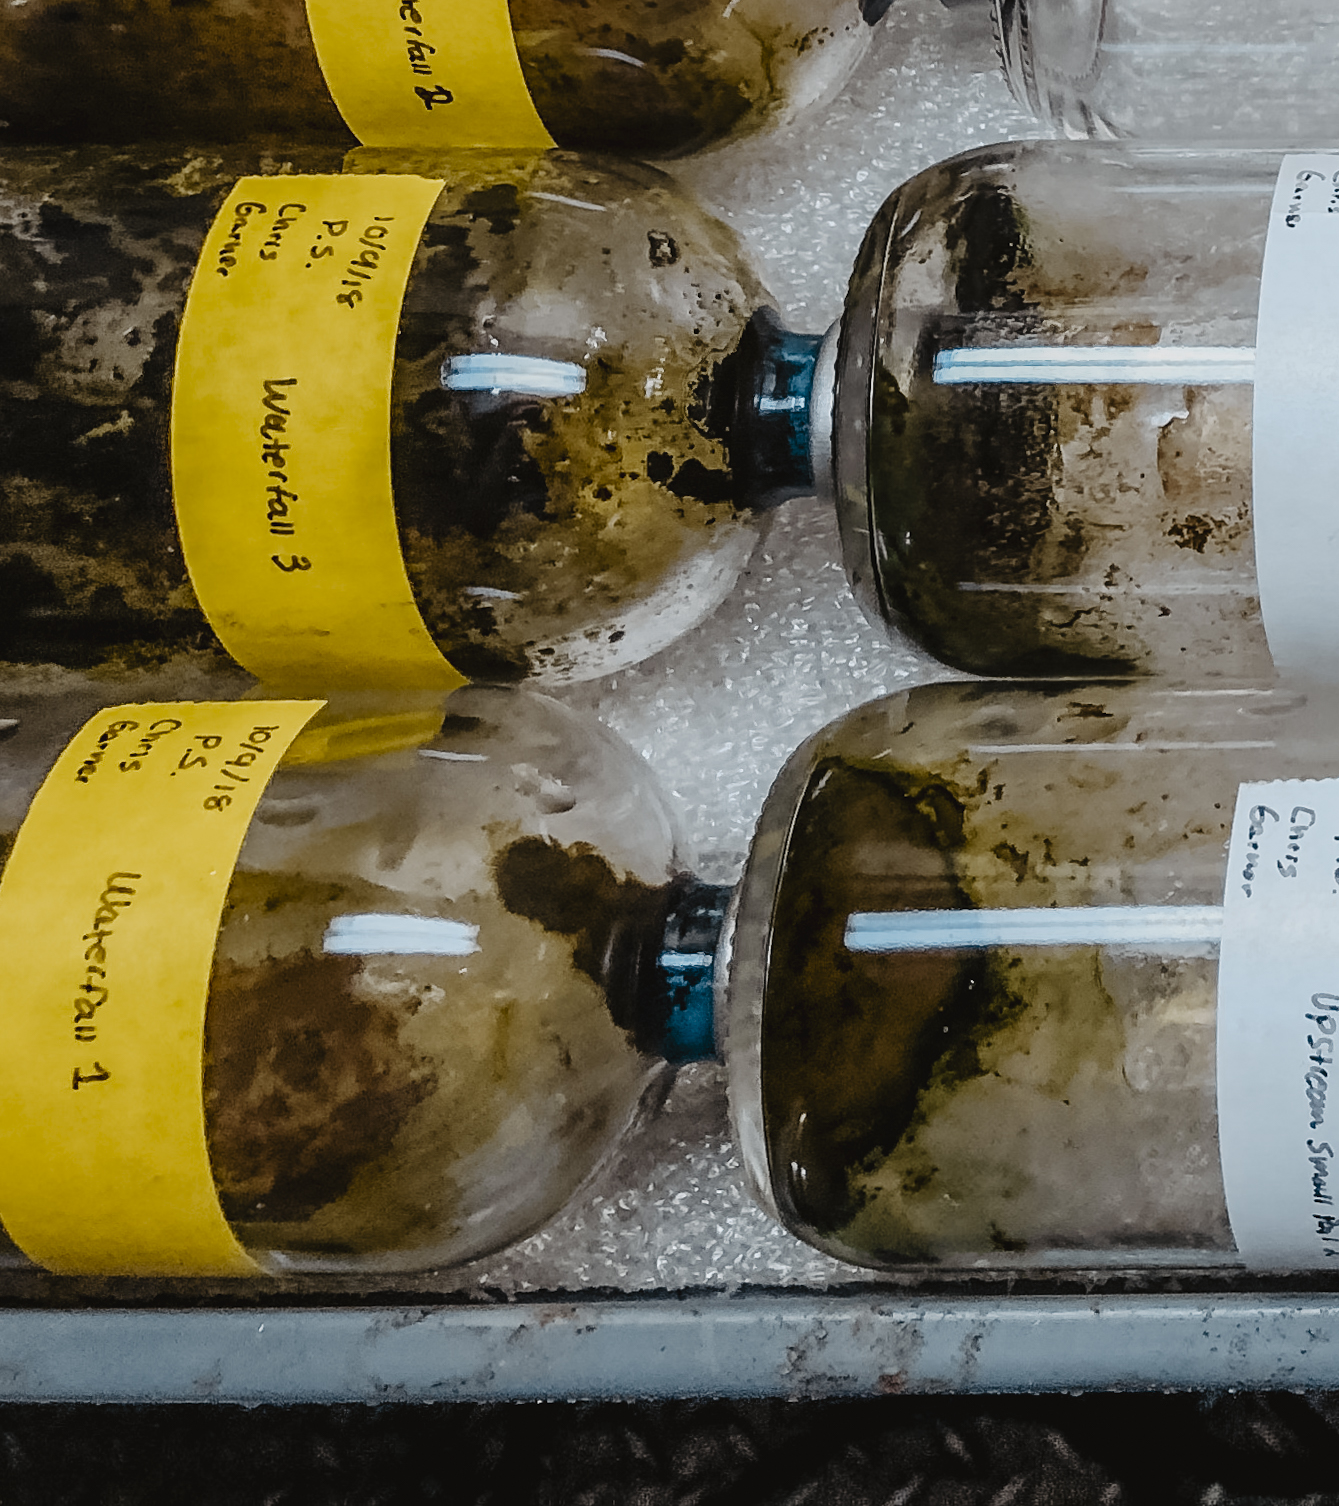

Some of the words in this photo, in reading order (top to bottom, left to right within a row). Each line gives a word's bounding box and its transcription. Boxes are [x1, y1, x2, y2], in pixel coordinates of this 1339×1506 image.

[215, 200, 267, 278] Garner
[258, 201, 306, 261] Chris
[304, 218, 349, 269] P.S.
[335, 215, 395, 309] 10/9/18
[259, 376, 299, 536] Waterfall
[271, 554, 312, 573] 3
[119, 717, 183, 774] Chris
[169, 734, 222, 777] P.S.
[202, 723, 280, 813] 10/9/18
[72, 871, 143, 1044] Waterfall
[70, 1060, 112, 1091] 1
[1305, 1138, 1335, 1207] Small
